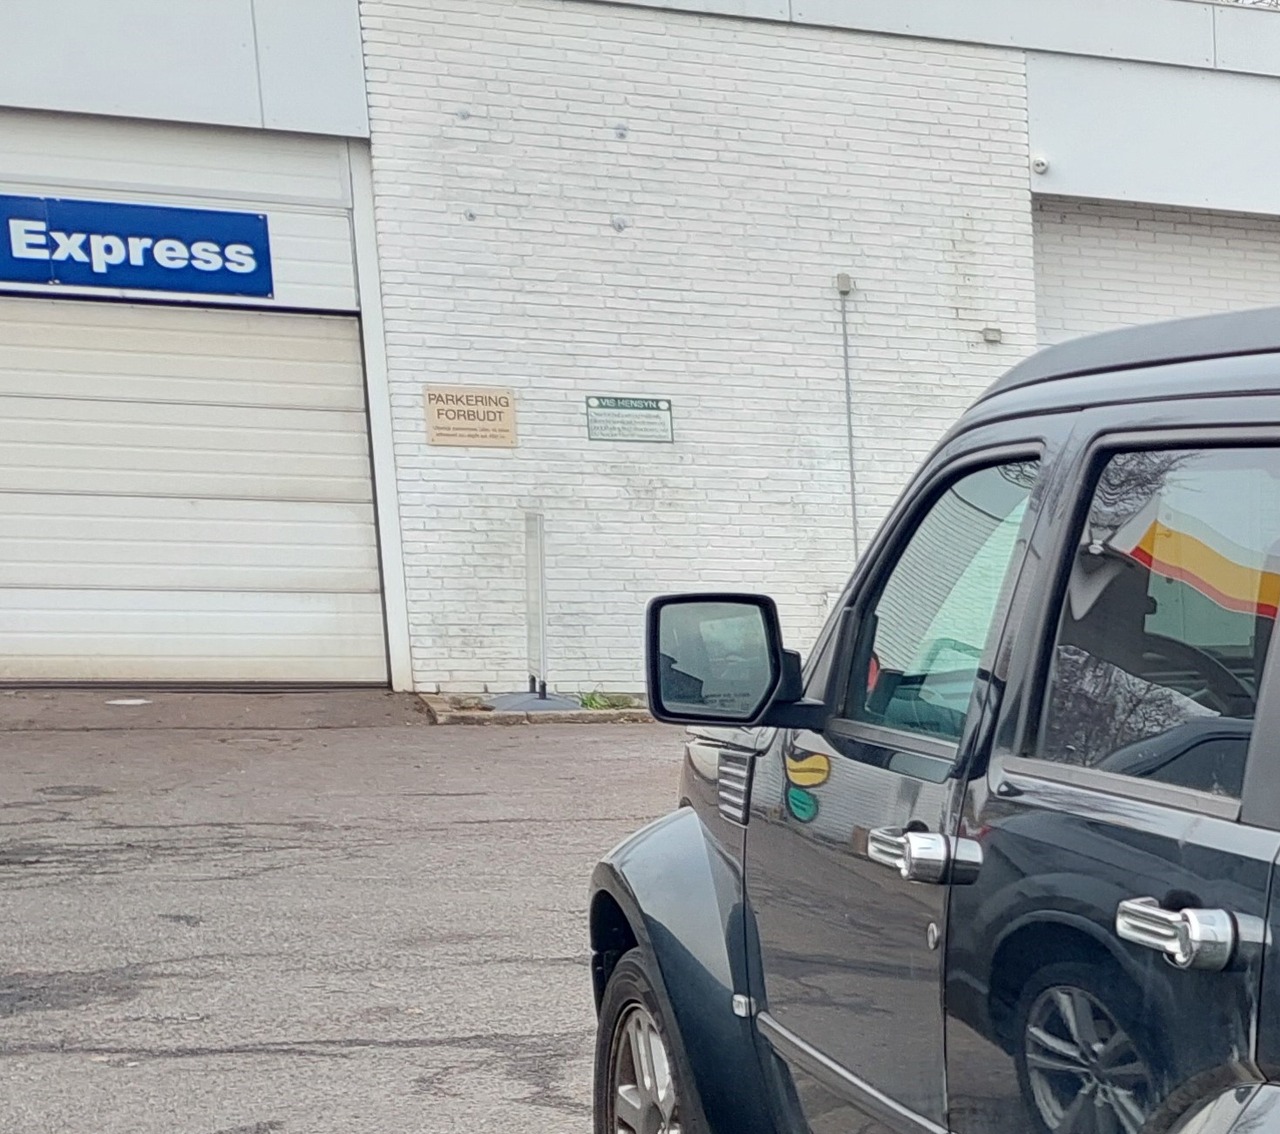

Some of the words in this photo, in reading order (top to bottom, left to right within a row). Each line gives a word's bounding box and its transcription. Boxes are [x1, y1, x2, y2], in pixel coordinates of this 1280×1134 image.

[8, 218, 257, 274] Express
[428, 393, 510, 408] PARKERING
[436, 409, 504, 422] FORBUDT
